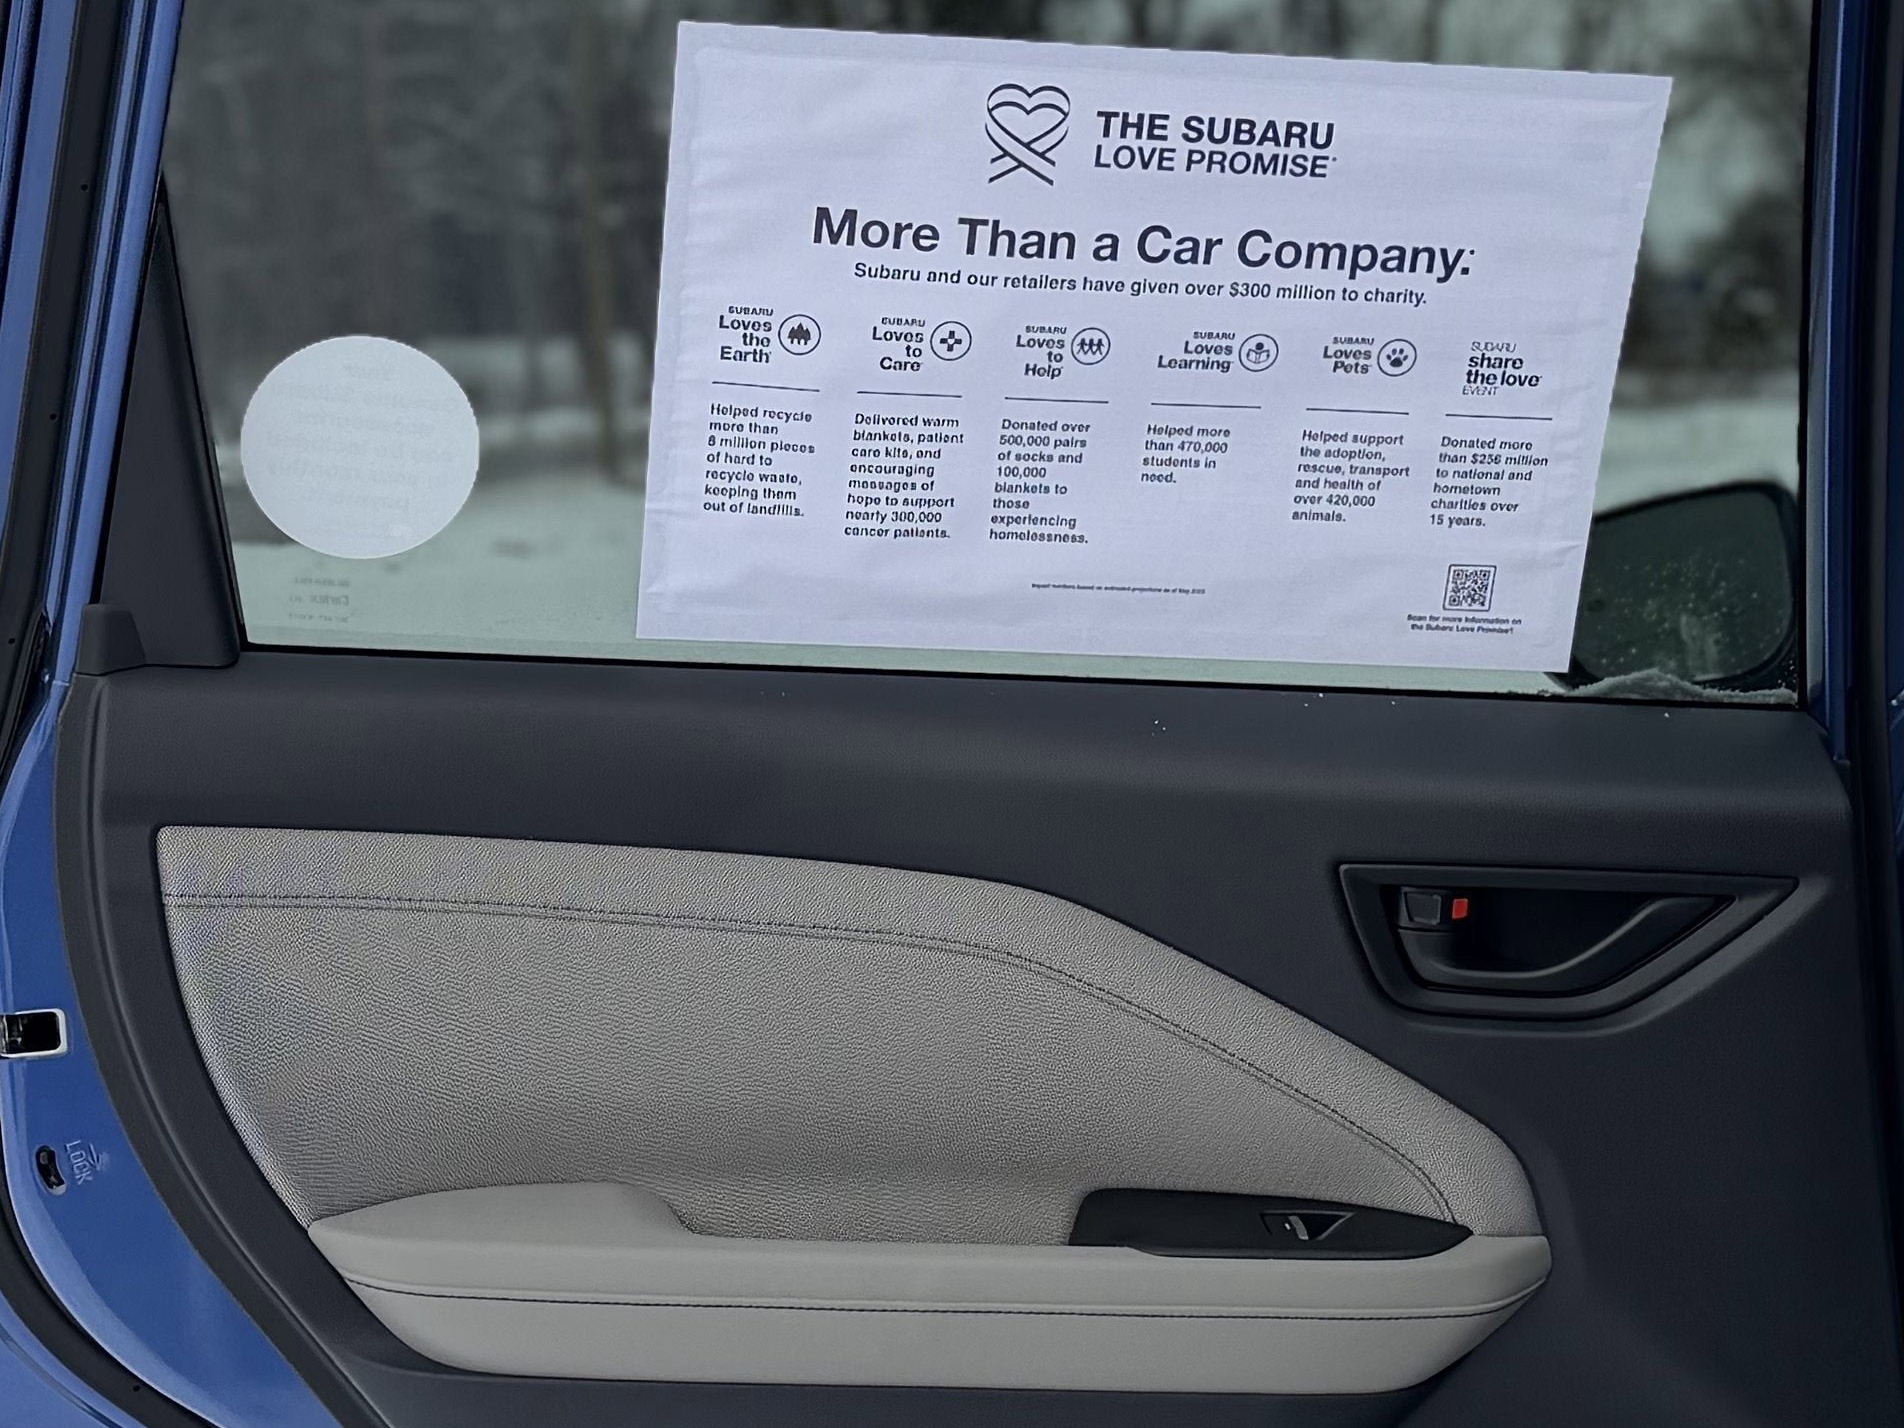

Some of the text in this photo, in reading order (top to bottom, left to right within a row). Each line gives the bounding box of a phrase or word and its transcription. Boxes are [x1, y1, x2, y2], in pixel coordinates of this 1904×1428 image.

[1096, 110, 1335, 150] THE SUBARU
[1093, 144, 1330, 178] LOVE PROMISE
[813, 206, 1471, 284] More Than a Car Company.
[854, 262, 1427, 308] Subaru and our retailers have given over $300 million to charity.
[728, 306, 774, 317] SUBARU
[718, 314, 773, 333] Loves
[881, 317, 926, 328] SUBARU
[1025, 325, 1067, 335] SUBARU
[742, 331, 771, 348] the
[872, 325, 924, 343] Loves
[1015, 334, 1066, 349] Loves
[1193, 331, 1235, 341] SUBARU
[1332, 336, 1375, 346] SUBARU
[720, 345, 770, 364] Earth
[905, 344, 923, 358] to
[1183, 340, 1234, 356] Loves
[1323, 345, 1372, 361] Loves
[1047, 350, 1063, 363] to
[1158, 355, 1232, 373] Learning
[1468, 353, 1524, 370] share
[879, 357, 921, 372] Care
[1024, 363, 1062, 380] Help
[1332, 360, 1369, 375] Pets
[1465, 369, 1539, 387] the love
[1461, 385, 1498, 396] EVENT
[710, 403, 813, 423] Helped recycle
[854, 413, 959, 428] Delivered warm
[709, 422, 779, 435] more than
[1001, 419, 1091, 434] Donated over
[1147, 424, 1231, 438] Helped more
[708, 435, 816, 454] 8 million pieces
[853, 429, 964, 445] blankets, patient
[999, 434, 1087, 450] 500,000 pairs
[1302, 430, 1404, 447] Helped support
[1441, 436, 1533, 451] Donated more
[851, 446, 941, 460] care kits, and
[1144, 440, 1228, 455] than 470,000
[1299, 446, 1386, 462] the adoption,
[707, 452, 773, 466] of hard to
[997, 450, 1083, 464] of socks and
[1142, 456, 1217, 469] students in
[1438, 452, 1467, 465] than
[1504, 454, 1549, 467] million
[705, 469, 802, 486] recycle waste,
[849, 464, 935, 478] encouraging
[997, 466, 1047, 479] 100,000
[1141, 471, 1177, 484] need.
[1298, 463, 1410, 479] rescue, transport
[1436, 468, 1532, 482] to national and
[848, 479, 935, 493] messages of
[994, 482, 1068, 495] blankets to
[1295, 478, 1382, 491] and health of
[1433, 482, 1501, 497] hometown
[704, 485, 797, 501] keeping them
[847, 493, 955, 509] hope to support
[992, 497, 1030, 509] those
[1293, 494, 1376, 509] over 420,000
[1430, 498, 1519, 512] charities over
[703, 501, 804, 517] out of landfills.
[845, 509, 942, 524] nearly 300,000
[1291, 510, 1346, 522] animals.
[990, 514, 1077, 529] experiencing
[1430, 514, 1486, 528] 15 years.
[844, 527, 951, 540] cancer patients.
[989, 528, 1089, 544] homelessness.
[65, 1139, 95, 1185] LOCK
